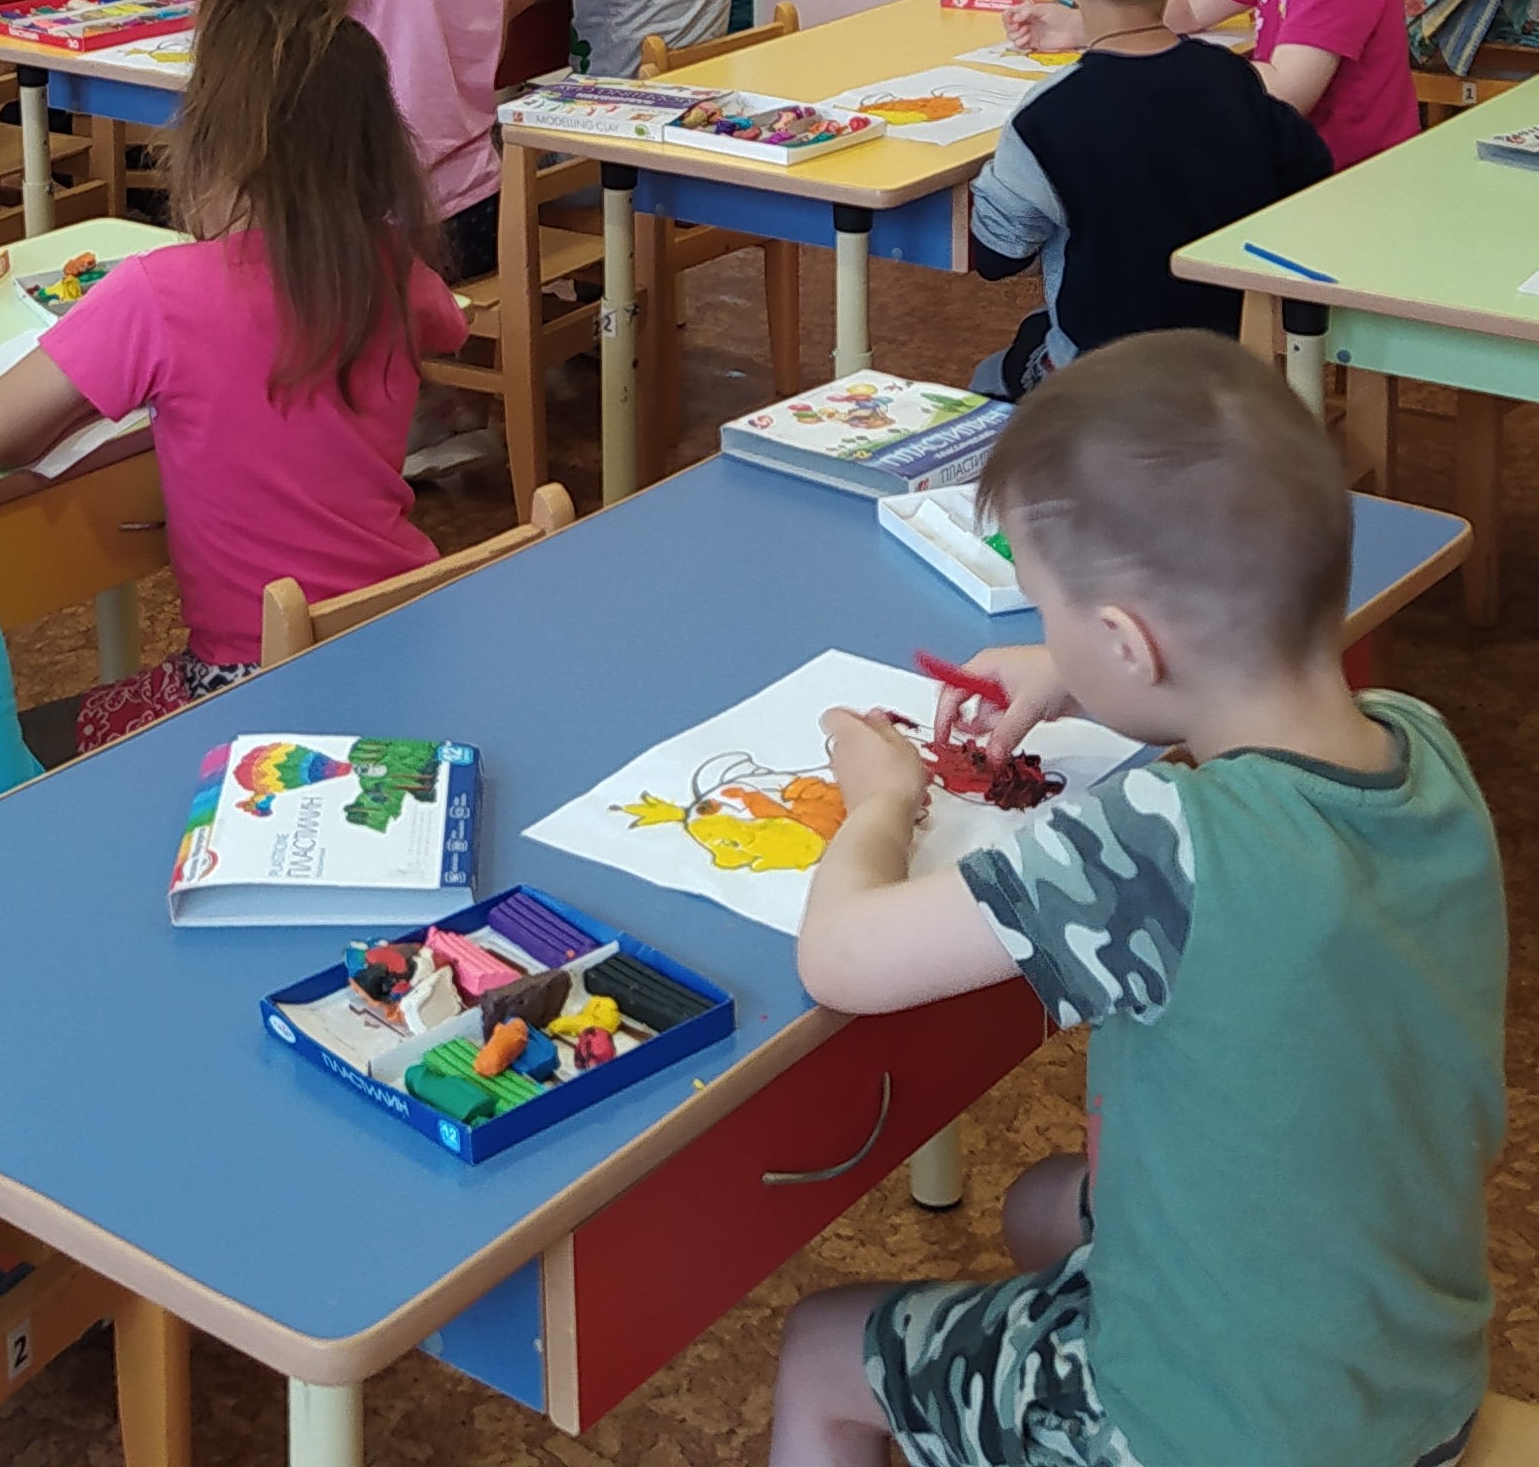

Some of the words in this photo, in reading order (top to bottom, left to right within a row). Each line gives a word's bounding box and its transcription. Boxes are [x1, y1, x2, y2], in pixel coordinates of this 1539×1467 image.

[1466, 88, 1474, 99] 1
[535, 115, 595, 131] MODELLING
[596, 120, 620, 133] CLAY
[603, 315, 613, 332] 2
[879, 412, 1009, 467] ПЛАСТИЛИН
[286, 796, 323, 879] ПЛАСТИЛИН
[321, 1051, 410, 1117] ПЛАСТИЛИН
[439, 1120, 458, 1142] 12
[14, 1334, 28, 1368] 2
